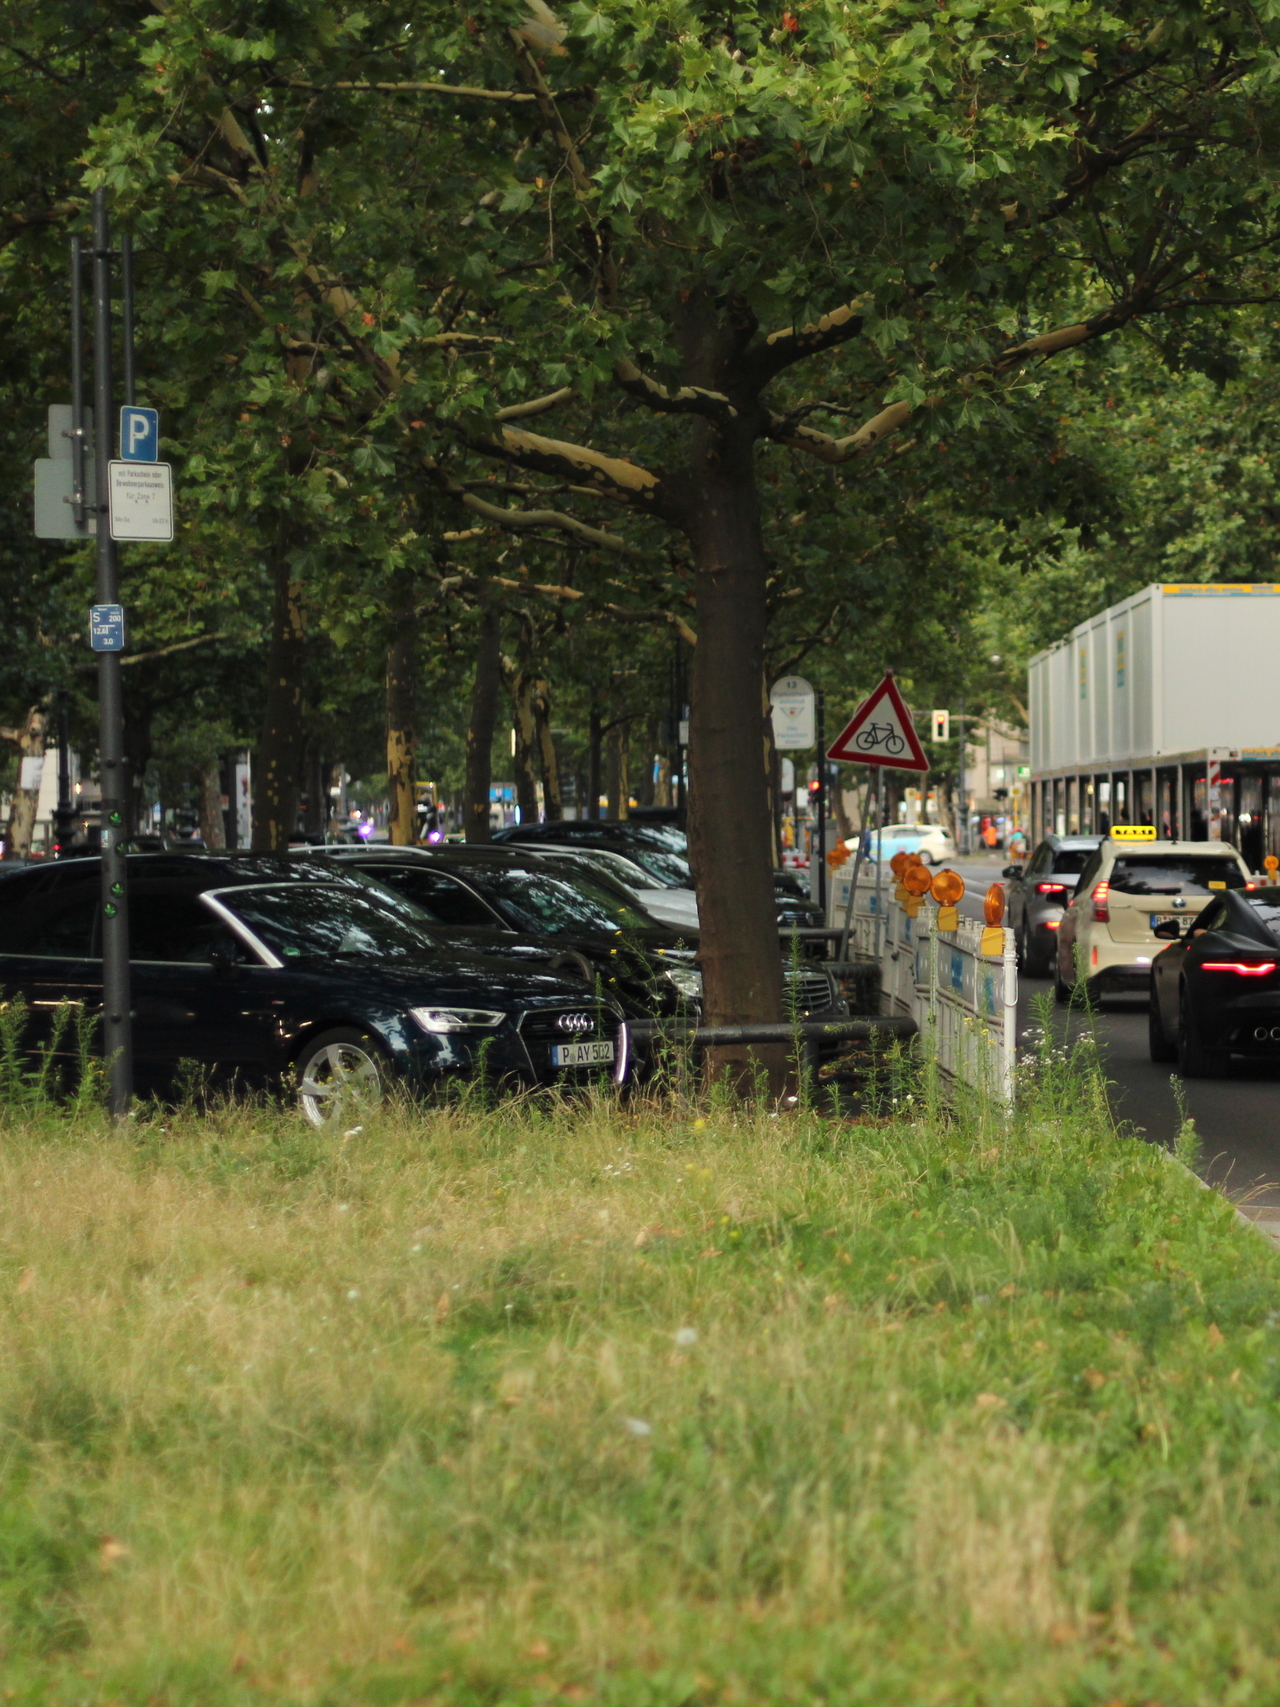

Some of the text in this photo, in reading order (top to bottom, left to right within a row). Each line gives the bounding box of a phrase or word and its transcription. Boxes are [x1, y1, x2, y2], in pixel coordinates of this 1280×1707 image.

[129, 413, 149, 454] P
[137, 492, 150, 500] Zone
[93, 612, 101, 622] S
[562, 1047, 570, 1063] P
[577, 1045, 591, 1062] AY
